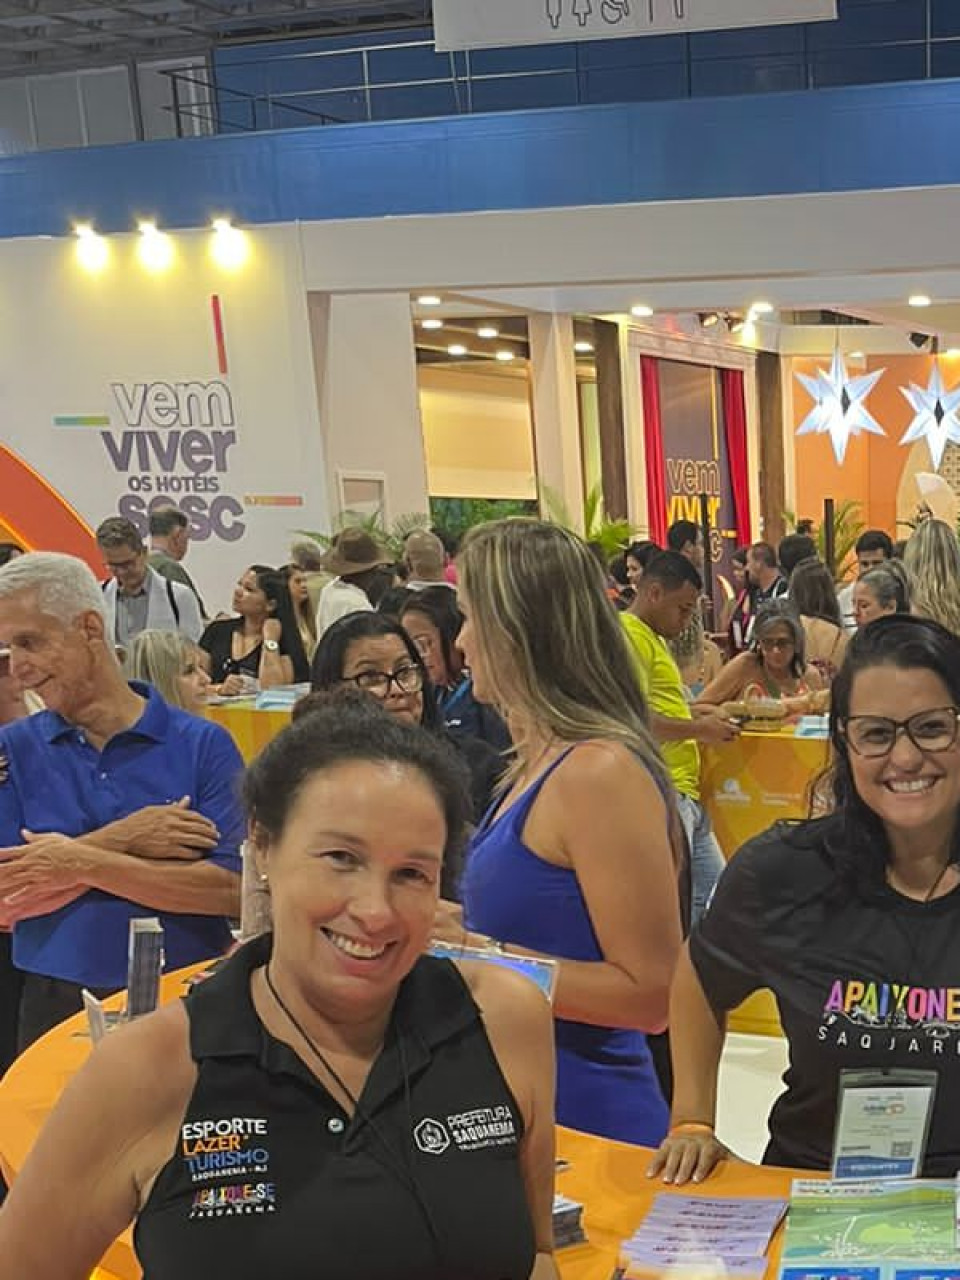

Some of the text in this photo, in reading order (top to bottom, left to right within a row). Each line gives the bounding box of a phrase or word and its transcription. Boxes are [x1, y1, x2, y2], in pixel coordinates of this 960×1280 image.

[110, 381, 235, 427] vem
[101, 429, 236, 473] viver
[128, 476, 152, 491] OS
[666, 458, 721, 495] vem
[182, 1117, 268, 1139] ESPORTE
[183, 1134, 241, 1156] LAZER
[187, 1148, 269, 1172] TURISMO
